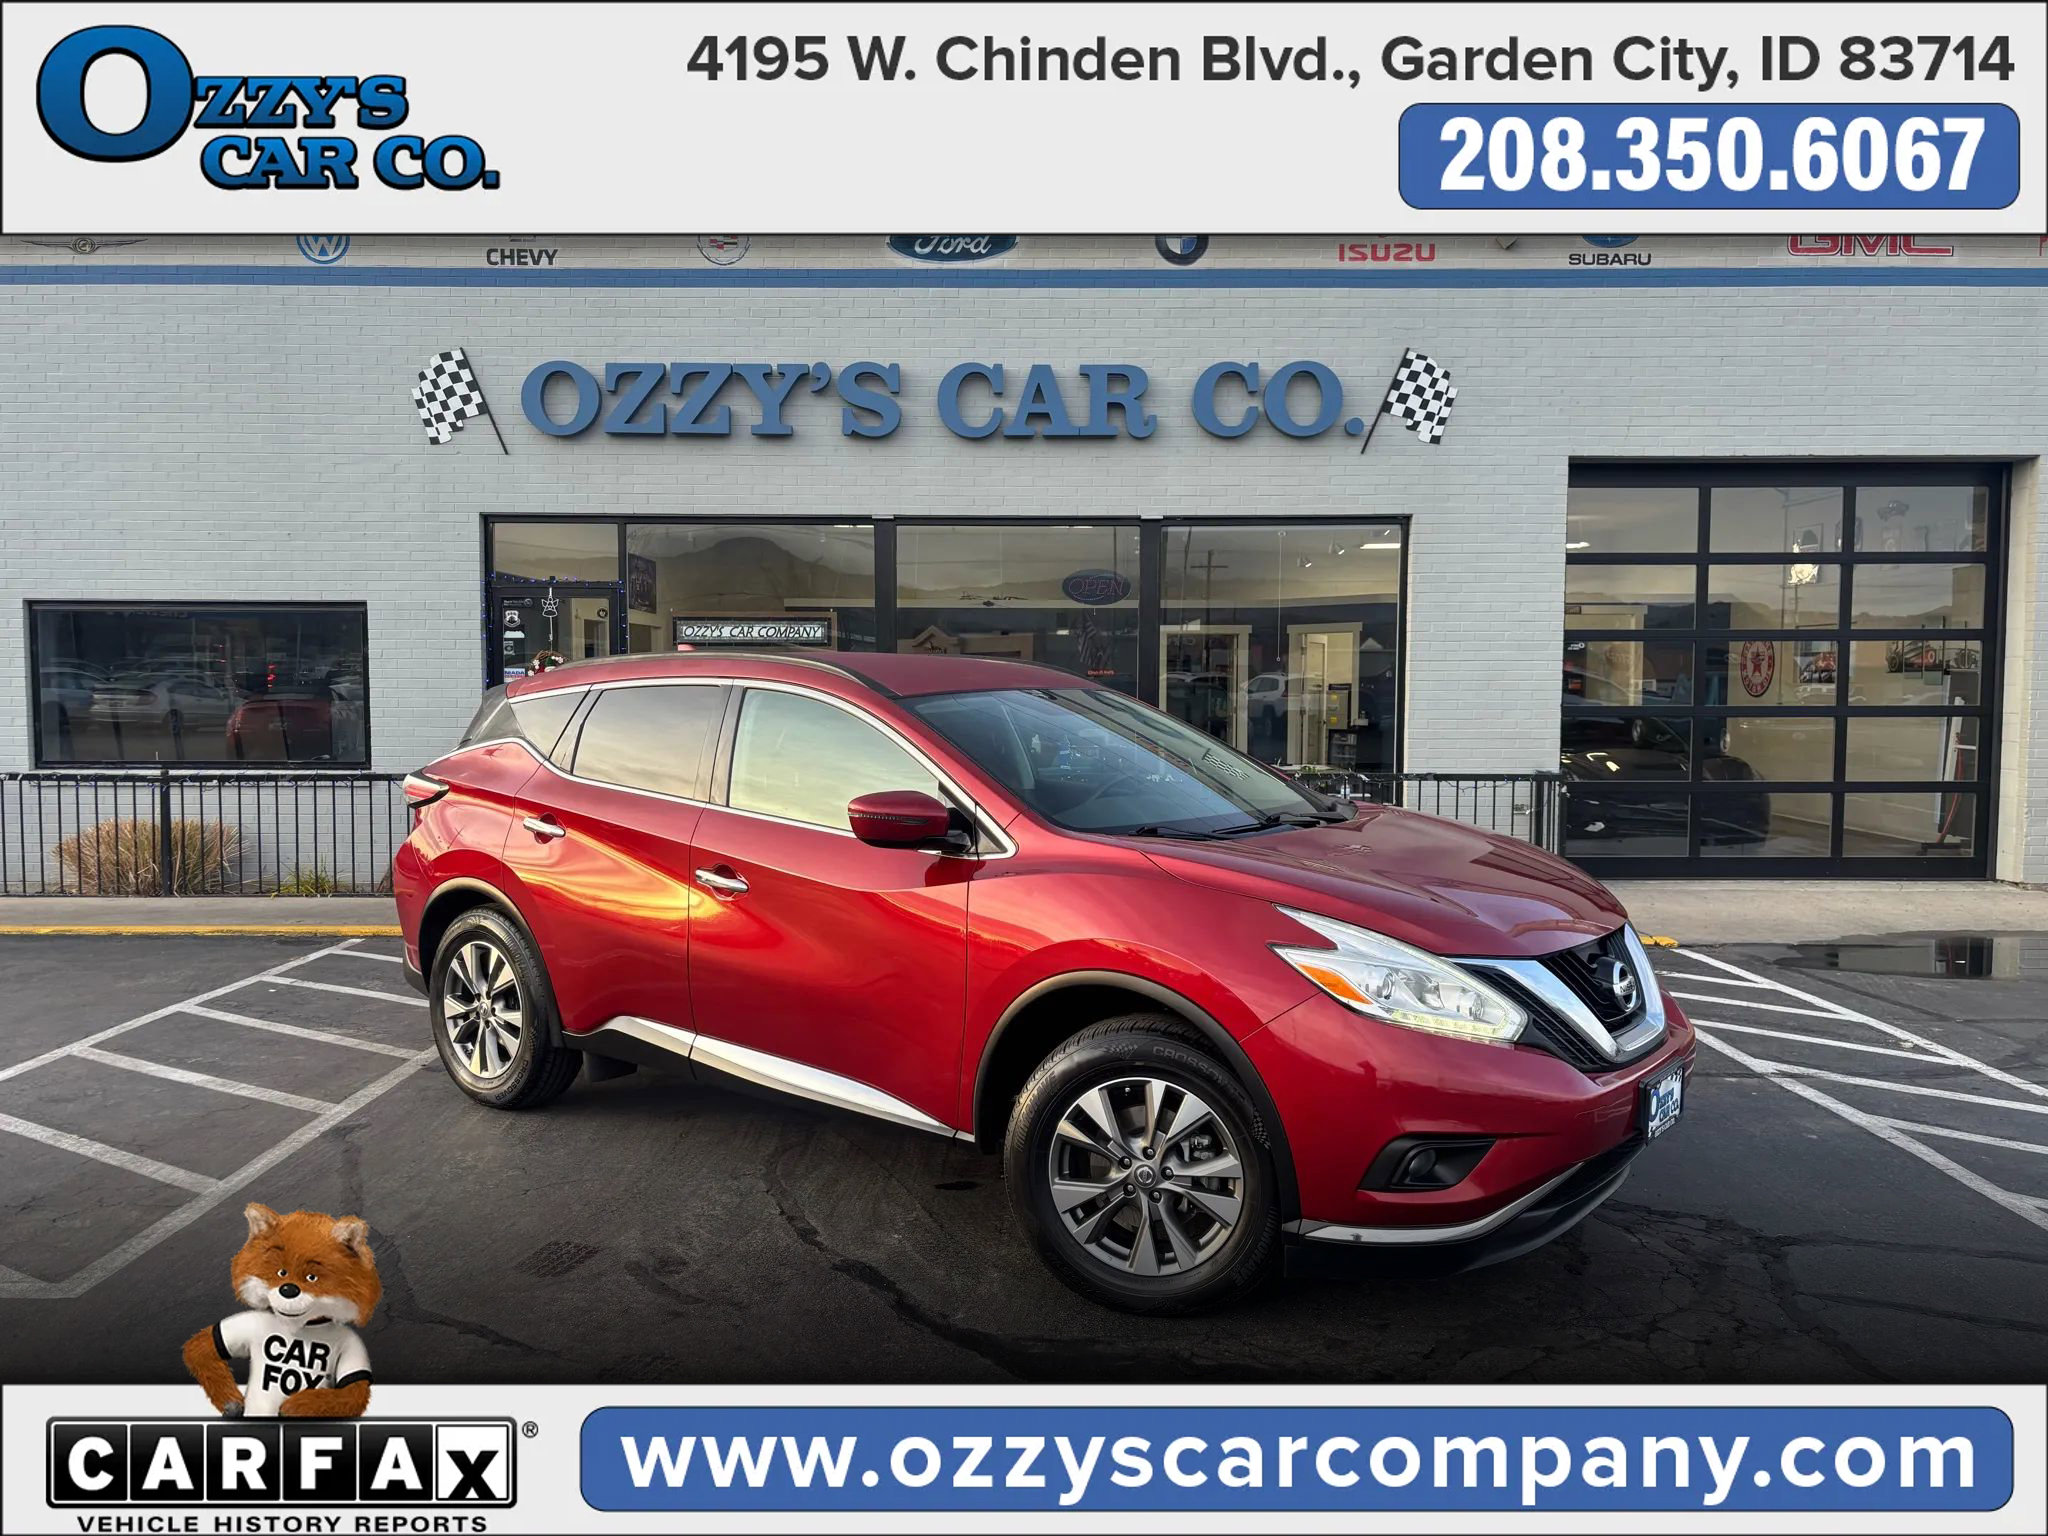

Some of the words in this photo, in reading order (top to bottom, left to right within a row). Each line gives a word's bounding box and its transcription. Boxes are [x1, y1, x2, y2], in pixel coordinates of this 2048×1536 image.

[914, 235, 993, 255] Ford
[1338, 243, 1435, 262] ISUZU
[1787, 235, 1954, 257] GMC
[486, 249, 558, 265] CHEVY
[1568, 253, 1652, 266] SUBARU
[520, 360, 901, 438] OZZY'S
[936, 361, 1158, 439] CAR
[1192, 360, 1365, 438] CO.
[1068, 576, 1124, 596] OPEN
[684, 625, 724, 638] OZZY'S
[729, 625, 754, 638] CAR
[757, 625, 820, 638] COMPANY
